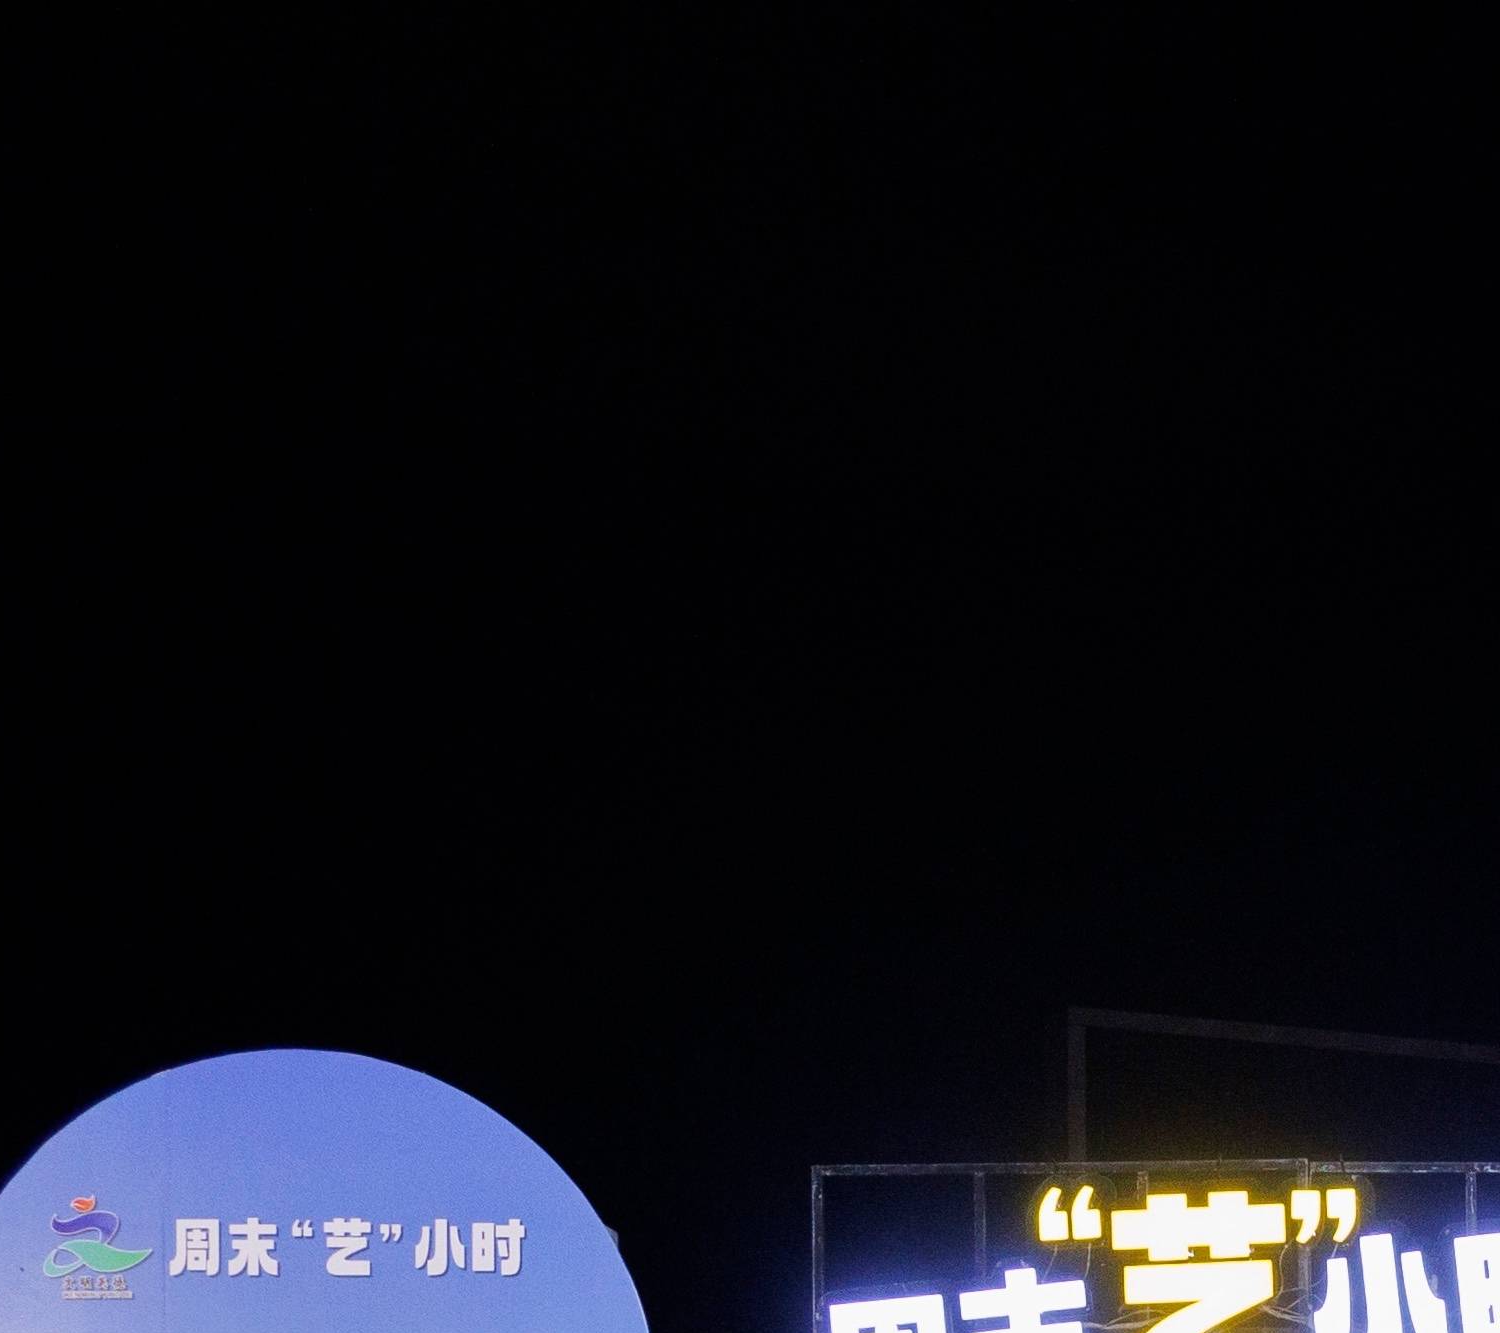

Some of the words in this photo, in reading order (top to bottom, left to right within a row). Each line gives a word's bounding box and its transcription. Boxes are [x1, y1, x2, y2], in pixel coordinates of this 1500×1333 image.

[169, 1217, 527, 1278] 周末“艺”小时
